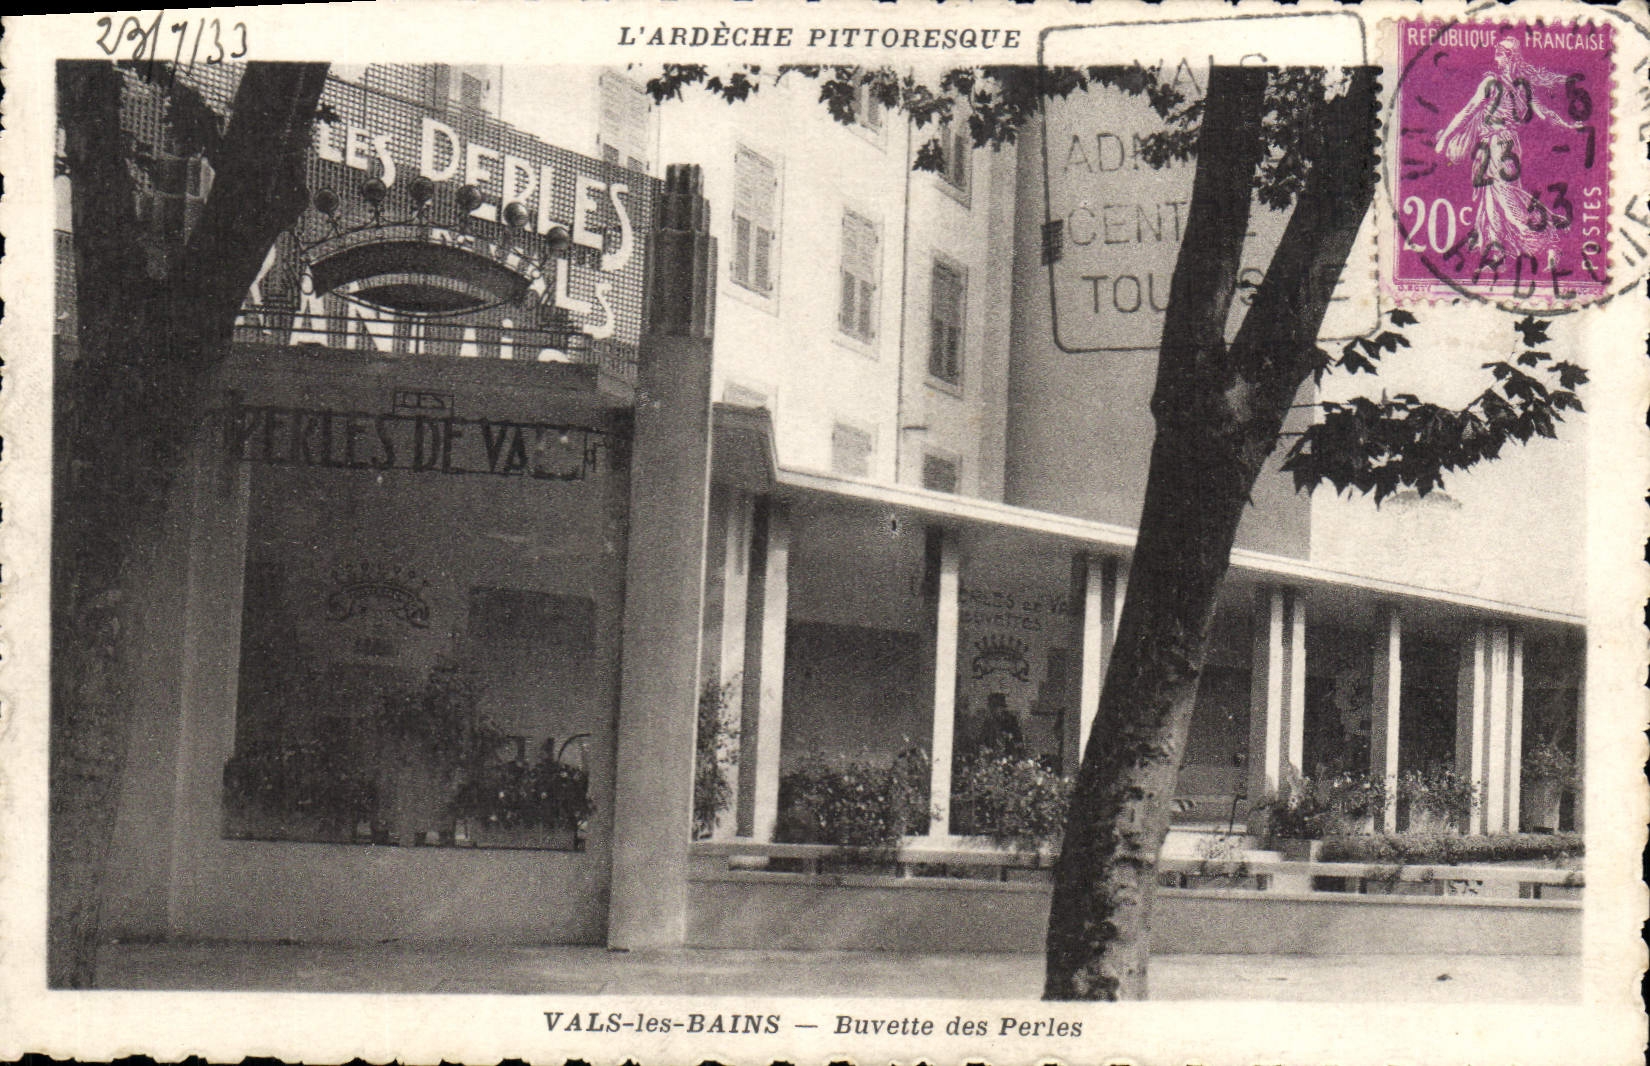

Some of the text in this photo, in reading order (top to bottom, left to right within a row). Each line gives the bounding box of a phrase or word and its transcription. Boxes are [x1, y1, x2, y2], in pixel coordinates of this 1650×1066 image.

[315, 120, 397, 189] LES
[1582, 186, 1602, 271] POSTES
[399, 390, 448, 409] LES
[413, 417, 468, 474] DE
